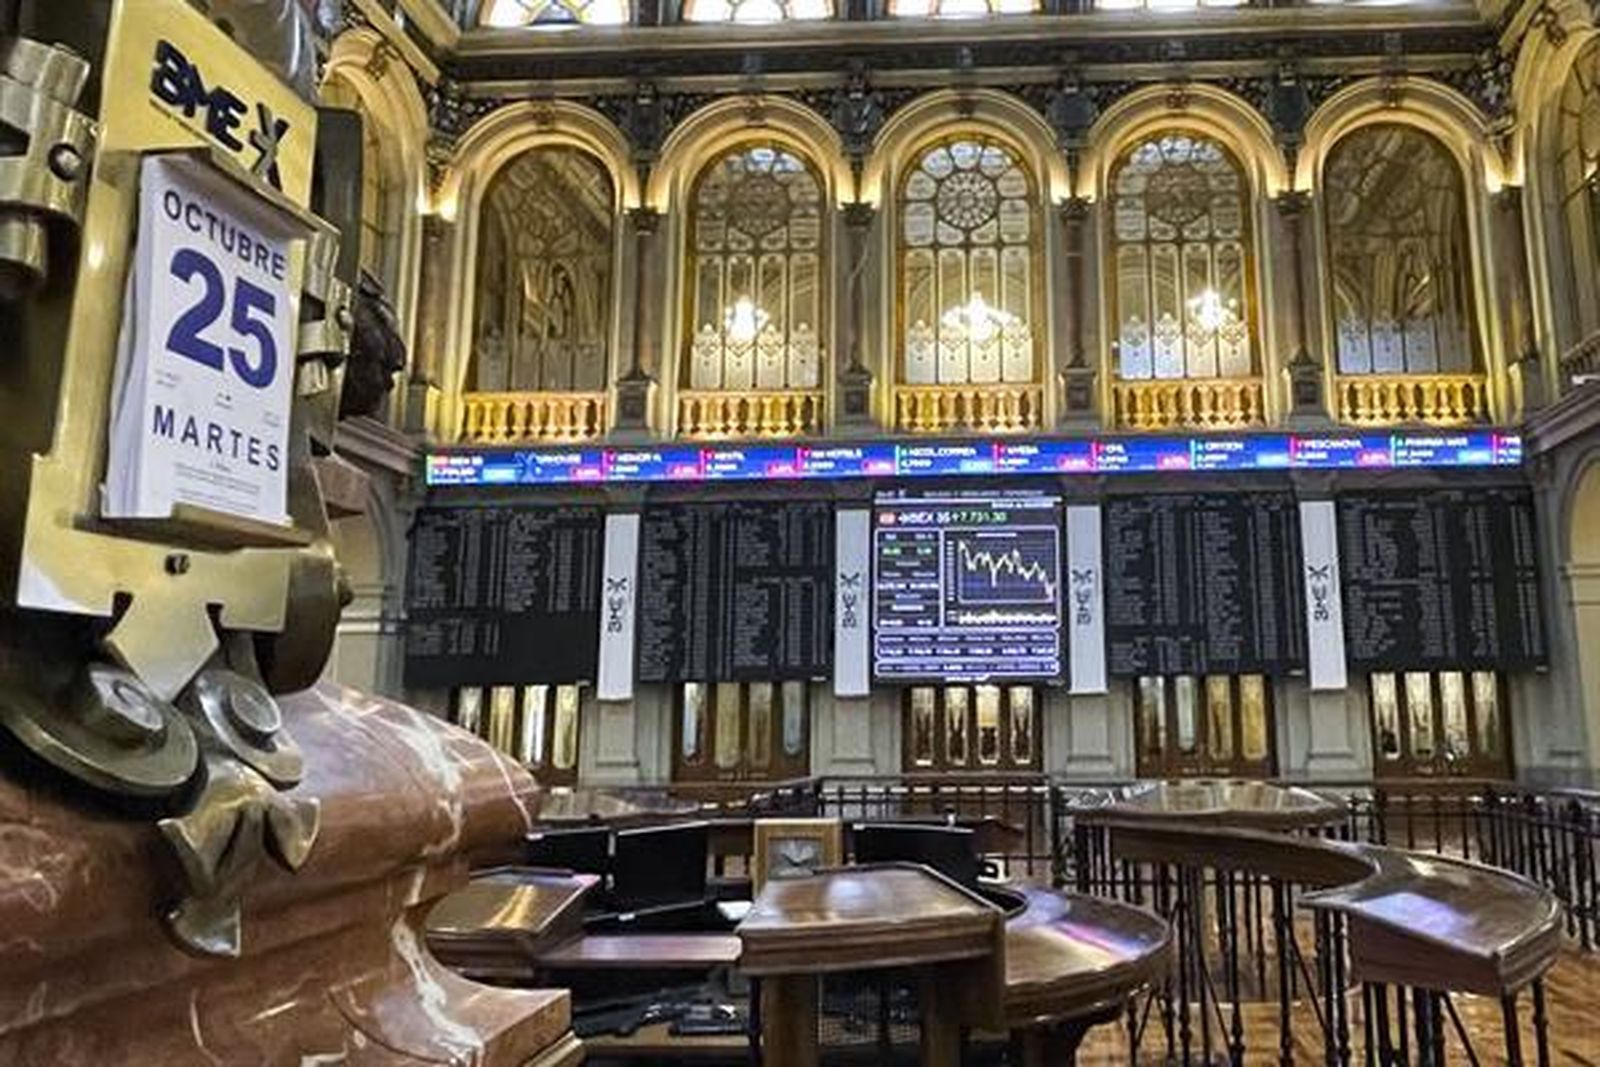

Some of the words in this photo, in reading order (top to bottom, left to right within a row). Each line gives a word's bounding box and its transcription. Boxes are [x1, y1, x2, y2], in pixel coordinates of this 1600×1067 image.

[164, 190, 286, 281] OCTUBRE
[166, 248, 278, 389] 25
[153, 404, 280, 472] MARTES
